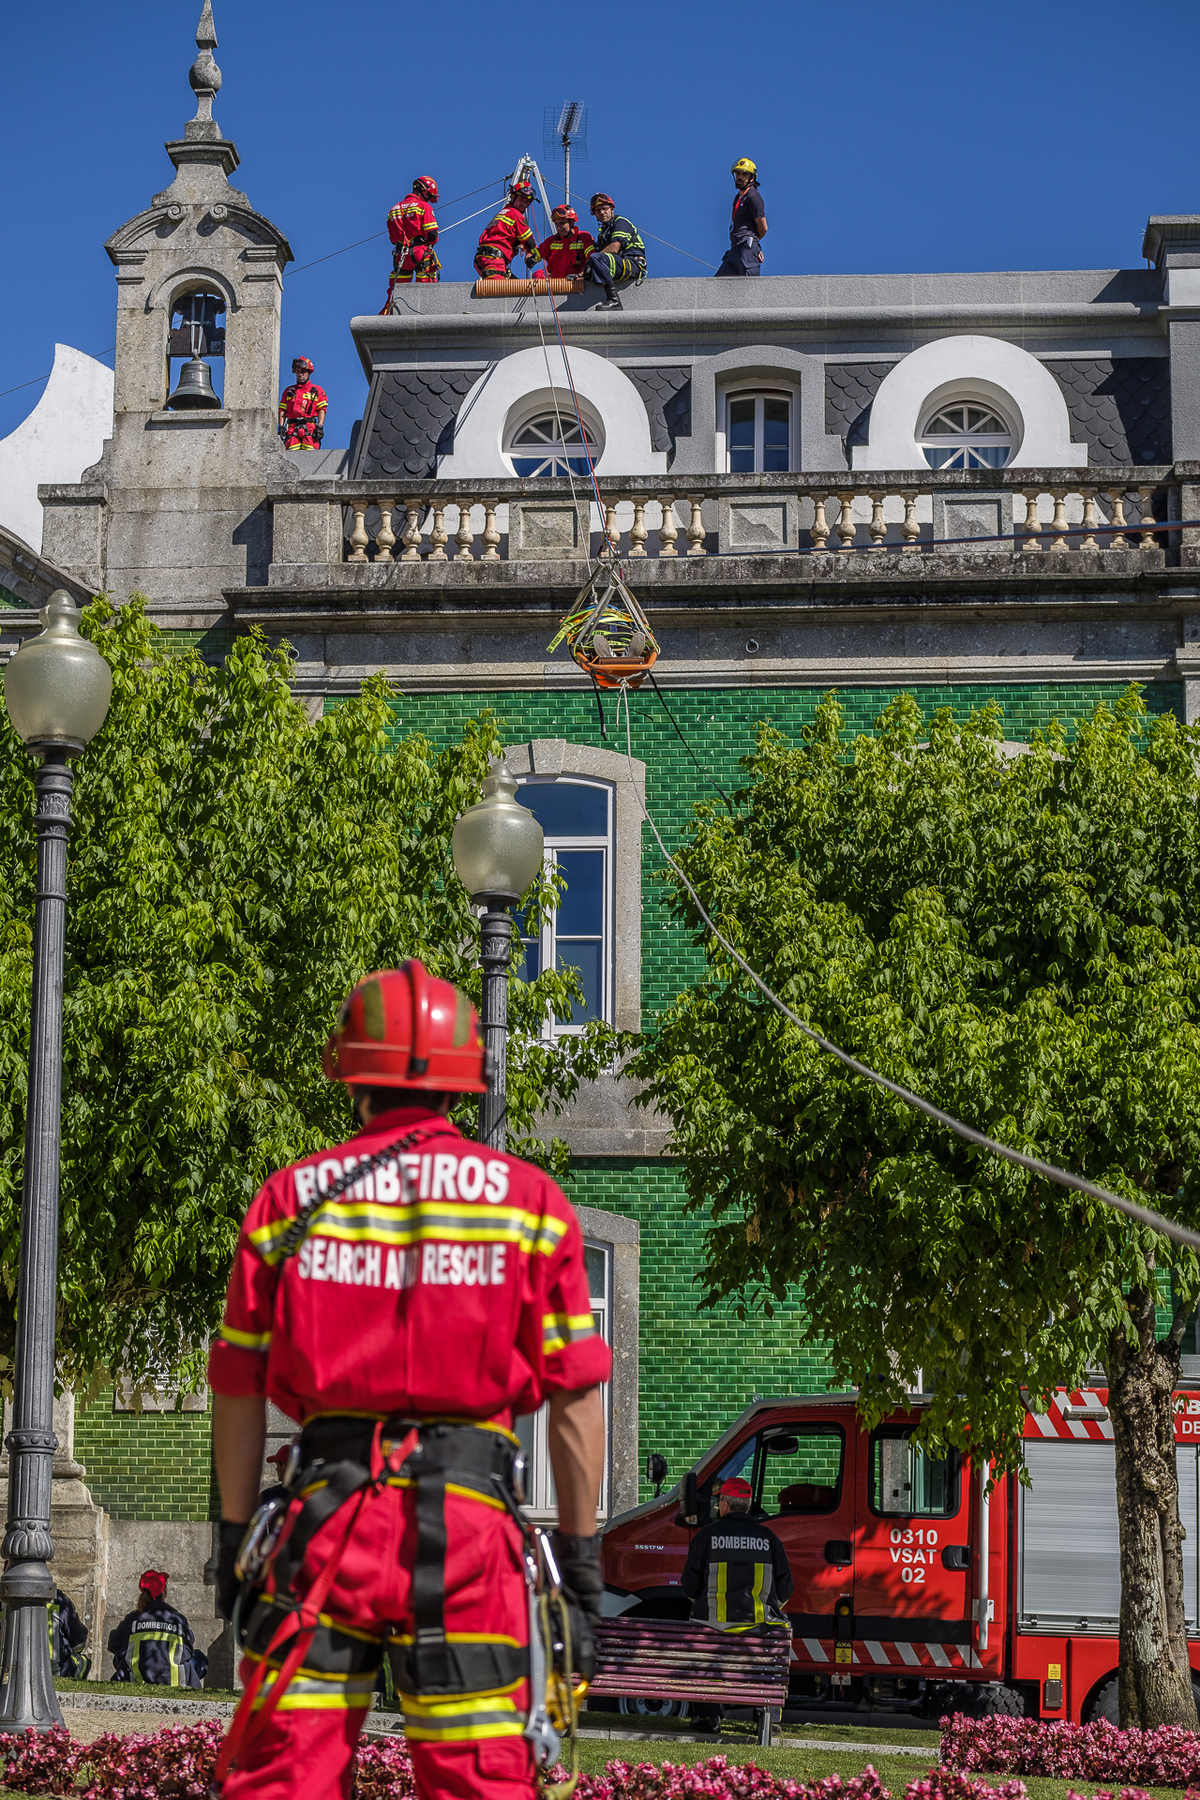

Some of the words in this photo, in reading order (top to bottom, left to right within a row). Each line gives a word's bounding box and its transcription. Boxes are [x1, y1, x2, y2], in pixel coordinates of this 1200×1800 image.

[294, 1153, 509, 1207] BOMBEIROS
[298, 1238, 381, 1287] SEARCH
[422, 1243, 506, 1286] RESCUE
[711, 1536, 770, 1551] BOMBEIROS
[890, 1528, 938, 1545] 0310
[889, 1547, 937, 1564] VSAT
[901, 1567, 925, 1583] 02
[137, 1621, 177, 1632] BOMBEIROS
